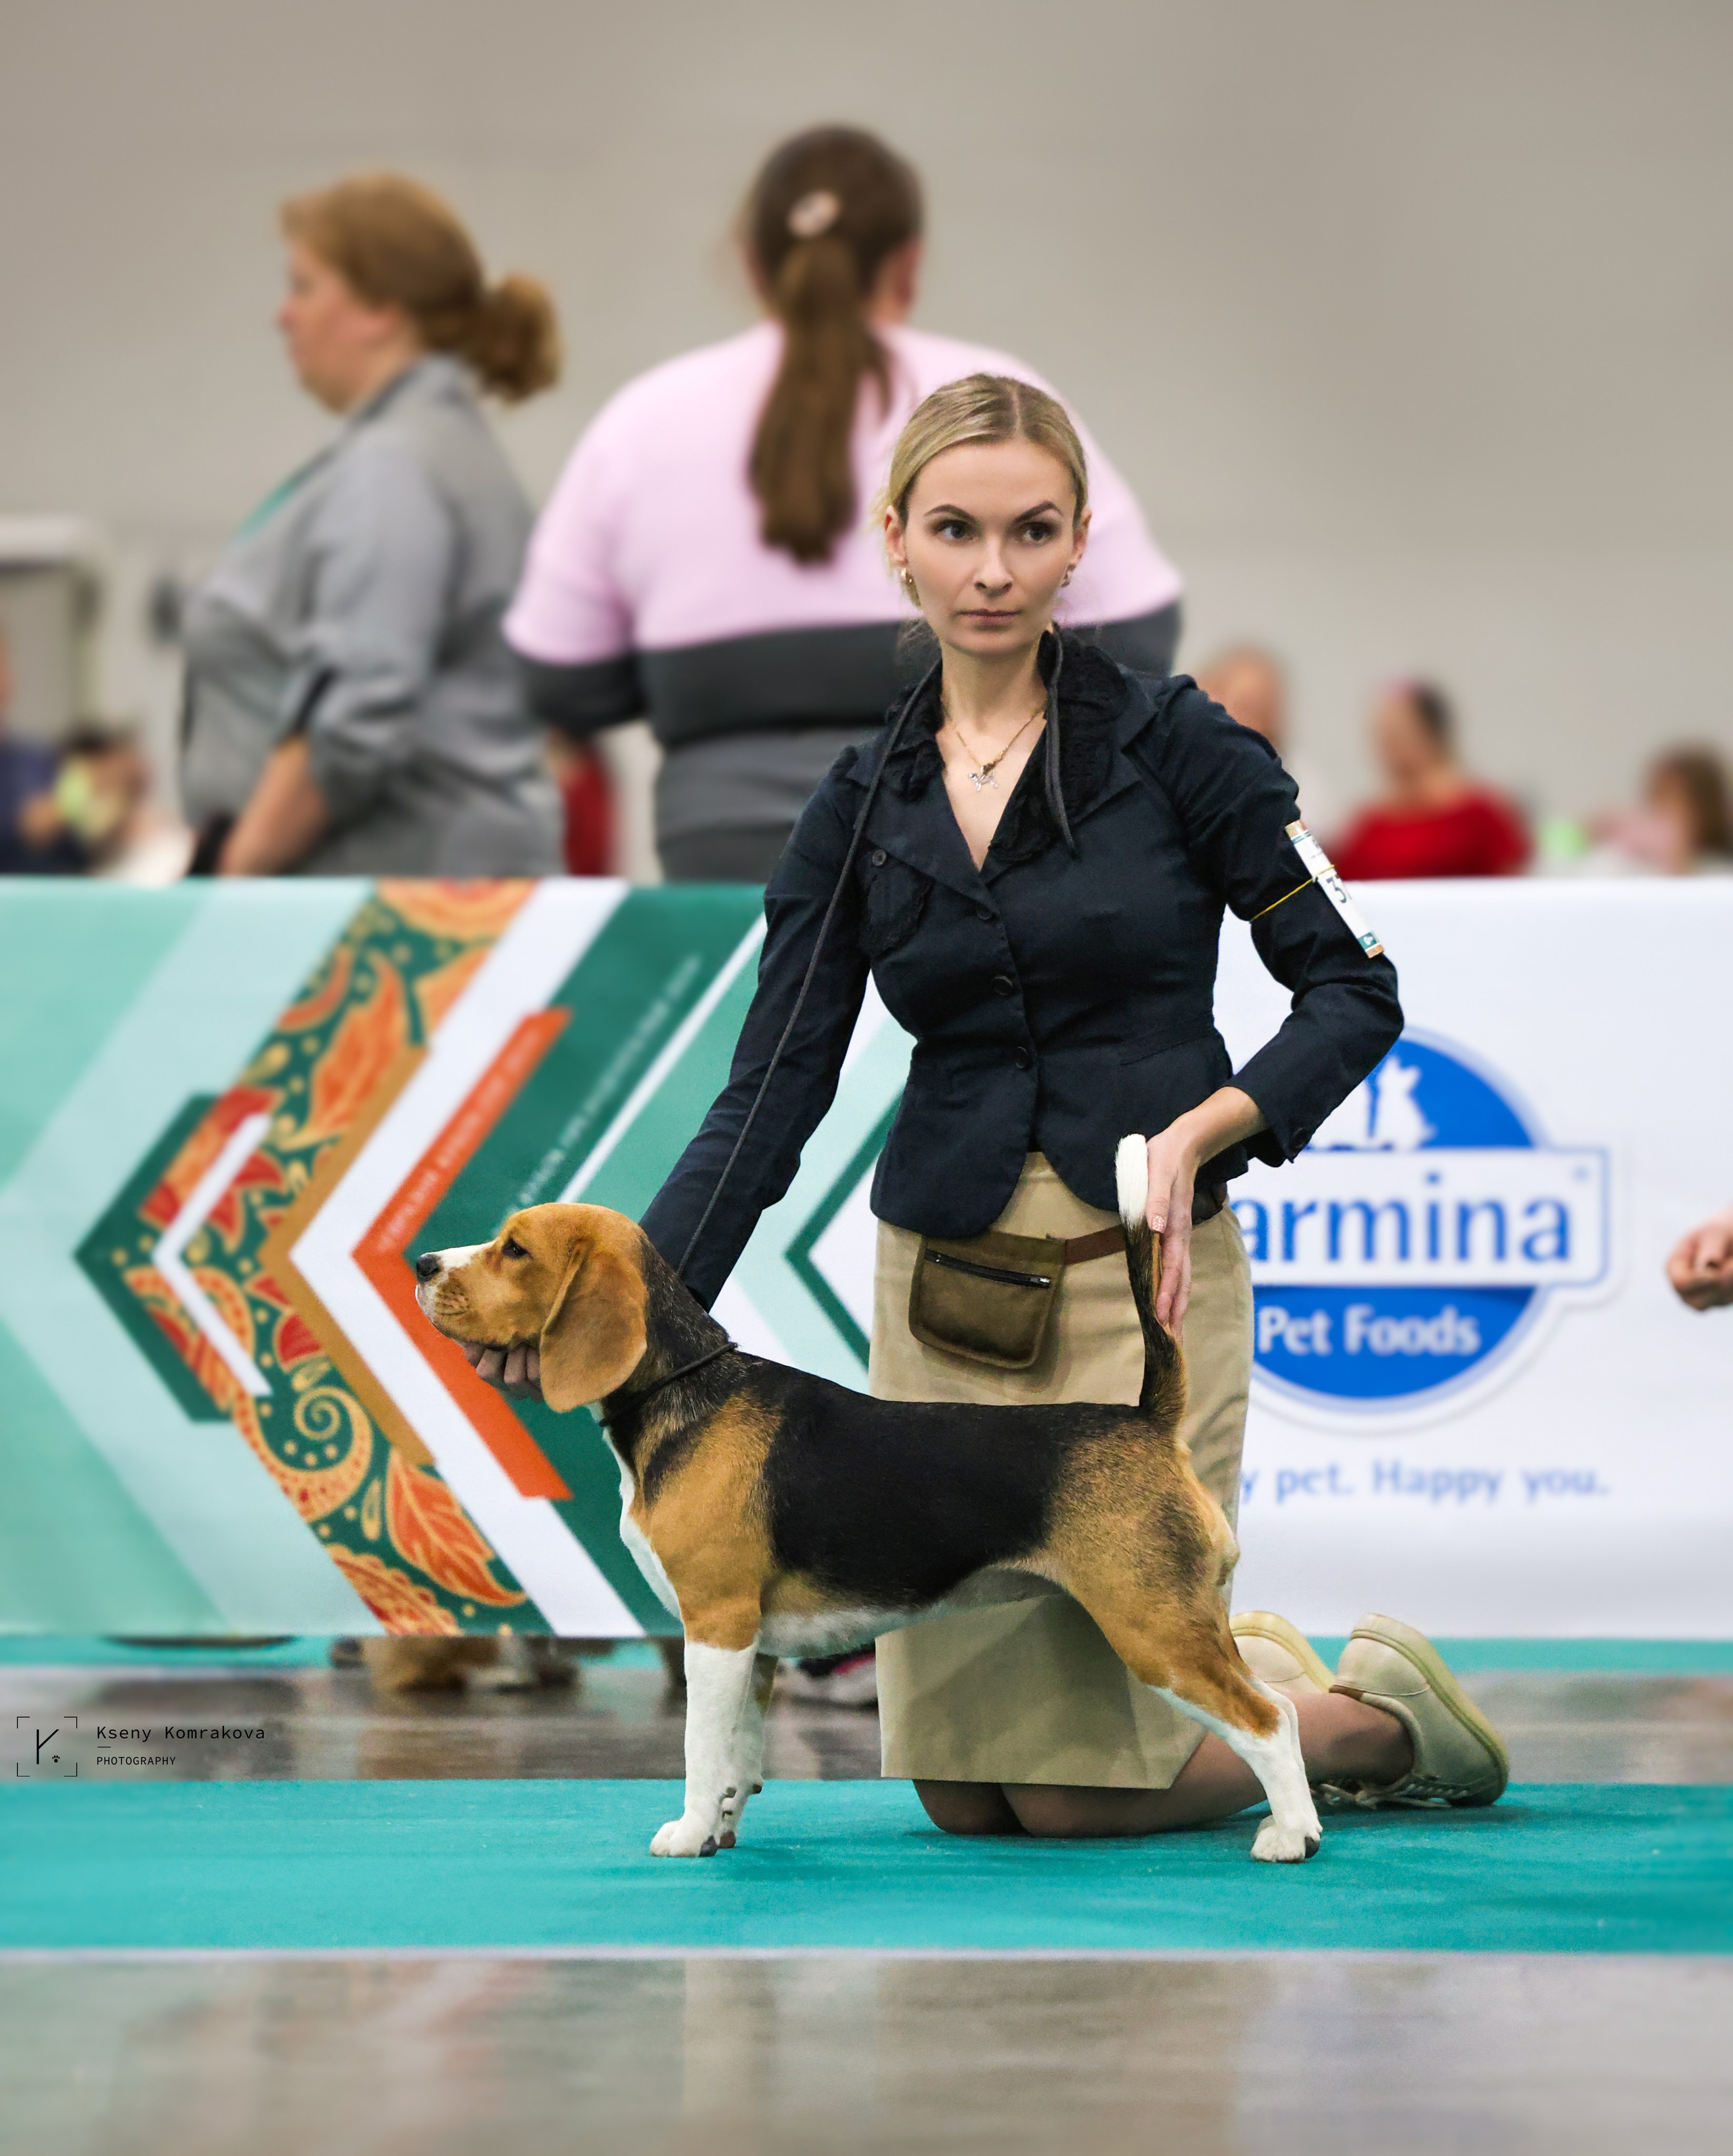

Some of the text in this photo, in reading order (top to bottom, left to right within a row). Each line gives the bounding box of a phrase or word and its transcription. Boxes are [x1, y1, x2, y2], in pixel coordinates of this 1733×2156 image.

[1229, 1169, 1570, 1264] armina
[1257, 1303, 1481, 1357] Pet Foods
[1275, 1461, 1354, 1505] pet.
[1372, 1459, 1504, 1504] Happy
[1521, 1467, 1610, 1504] you.
